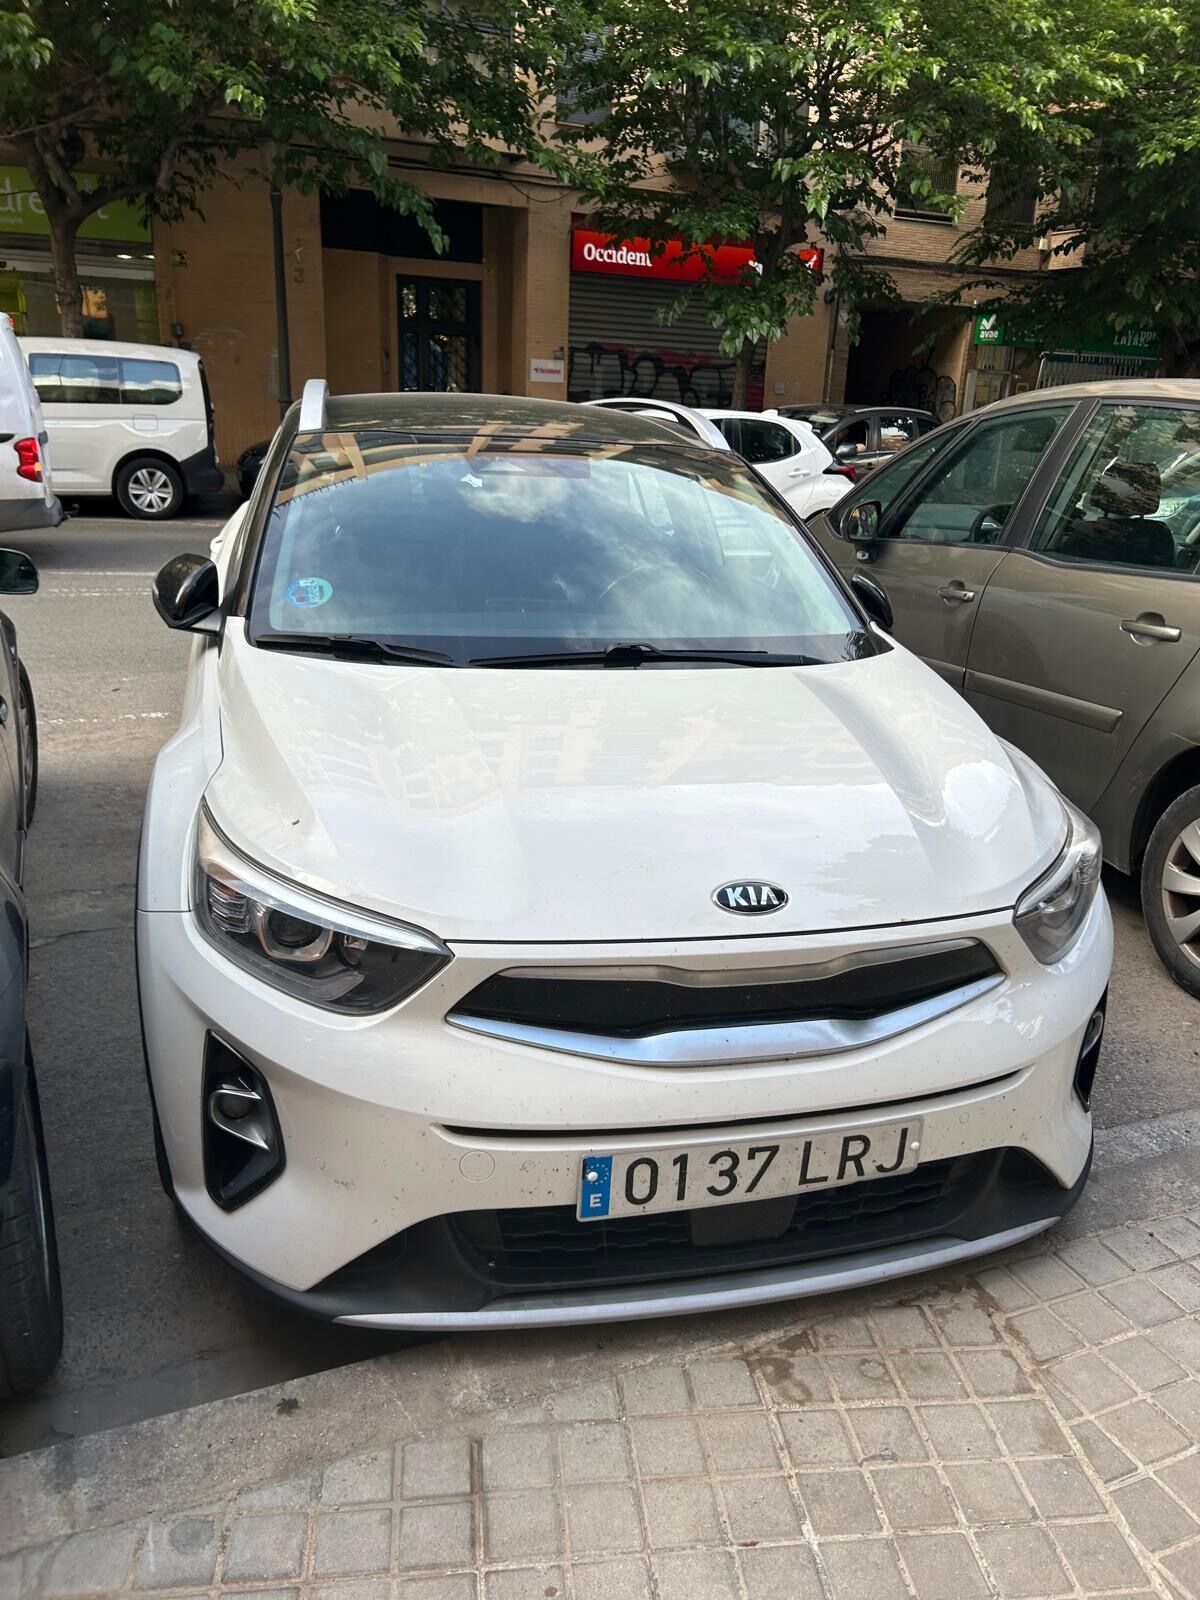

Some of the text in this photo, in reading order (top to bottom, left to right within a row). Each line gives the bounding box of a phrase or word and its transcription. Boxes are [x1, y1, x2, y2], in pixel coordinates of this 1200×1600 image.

[725, 886, 779, 907] KIA
[625, 1127, 908, 1205] 0137 LRJ
[589, 1193, 602, 1208] E
